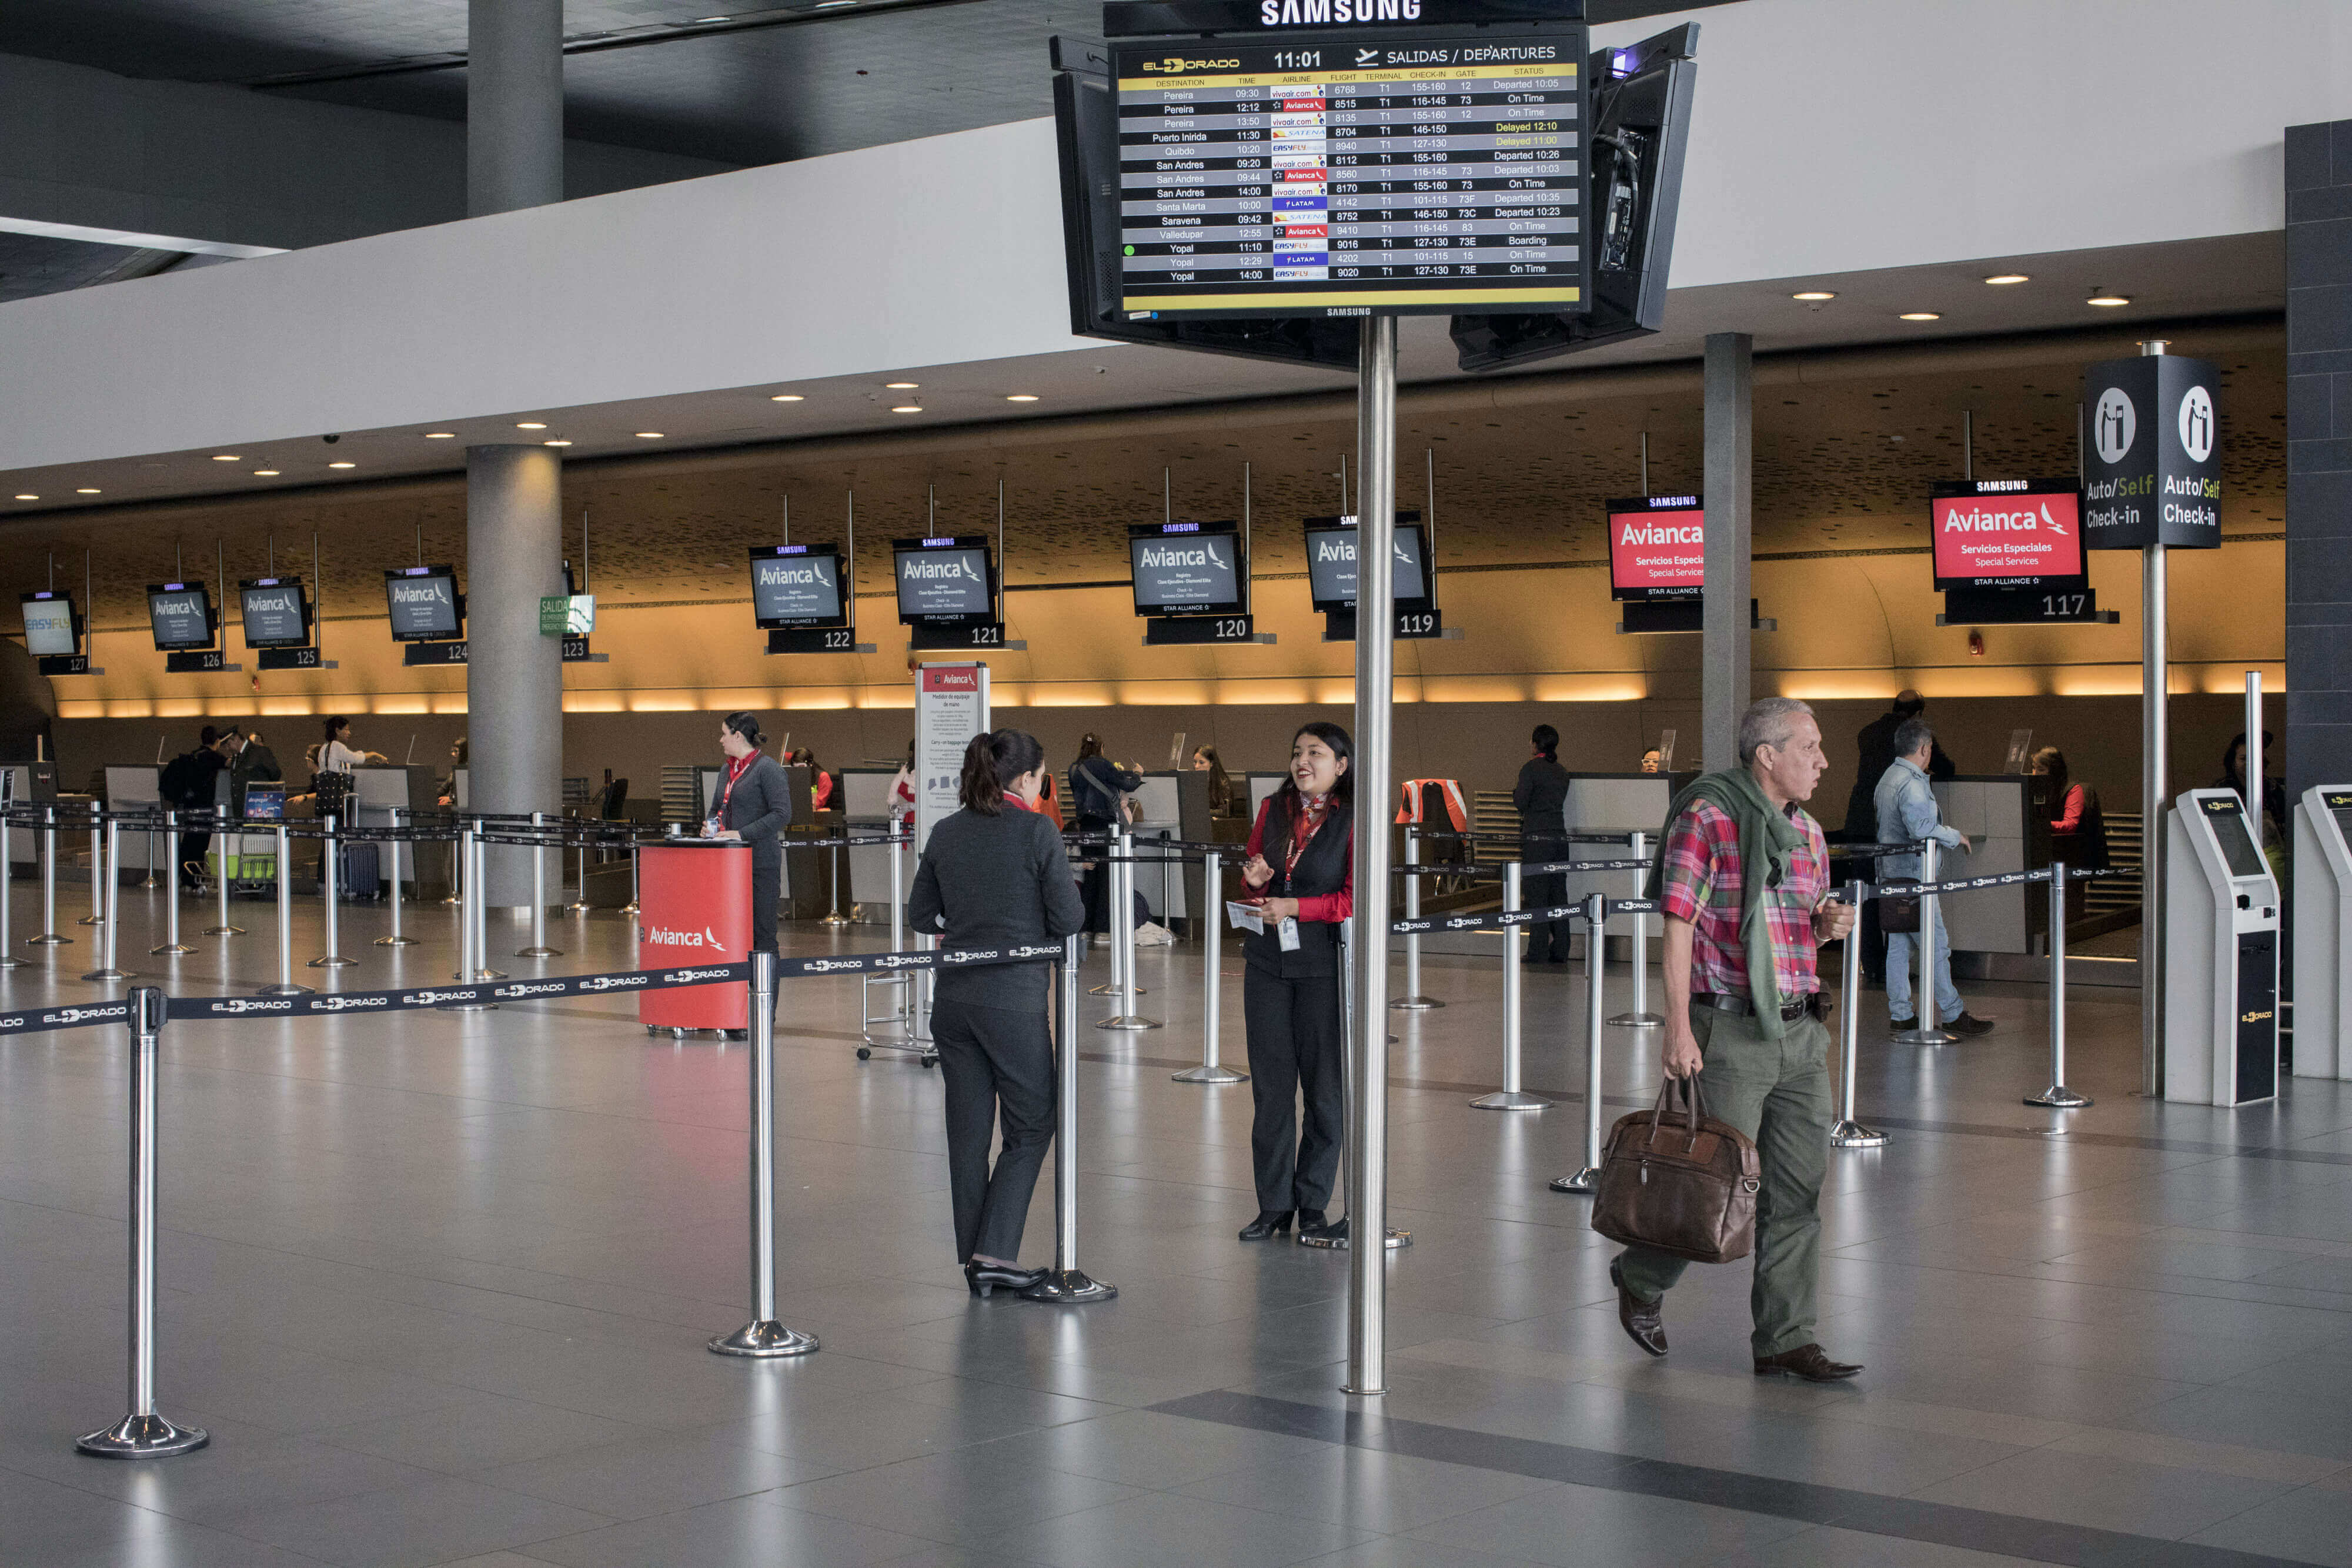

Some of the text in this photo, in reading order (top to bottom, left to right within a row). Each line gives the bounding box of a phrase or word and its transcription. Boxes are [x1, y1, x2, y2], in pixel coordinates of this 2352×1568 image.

[1261, 0, 1421, 25] SAMSUNG
[1274, 51, 1321, 68] 11:01
[1387, 50, 1448, 63] SALIDAS
[1464, 46, 1556, 61] DEPARTURES
[1156, 79, 1205, 87] DESTINATION
[1365, 72, 1402, 81] TERMINAL
[1164, 106, 1194, 114] Pereira
[1237, 103, 1259, 112] 12:12
[1335, 99, 1356, 109] 8515
[1380, 98, 1390, 106] T1
[1412, 96, 1446, 105] 116-145
[1461, 96, 1471, 105] 73
[1508, 95, 1522, 103] On
[1522, 94, 1544, 102] Time
[1152, 133, 1180, 142] Puerto
[1181, 133, 1207, 141] Inirida
[1237, 132, 1260, 141] 11:30
[1335, 128, 1357, 136] 8704
[1380, 126, 1391, 135] T1
[1412, 125, 1446, 133] 146-150
[1496, 123, 1531, 133] Delayed
[1532, 122, 1557, 131] 12:10
[1156, 161, 1174, 170] San
[1175, 160, 1204, 169] Andres
[1237, 159, 1260, 168] 09:20
[1336, 156, 1357, 165] 8112
[1381, 155, 1391, 163] T1
[1413, 153, 1447, 162] 155-160
[1494, 150, 1533, 161] Departed
[1535, 150, 1559, 159] 10:26
[1157, 189, 1174, 198] San
[1176, 188, 1205, 198] Andres
[1238, 187, 1261, 196] 14:00
[1337, 184, 1358, 193] 8170
[1381, 183, 1392, 192] T1
[1413, 181, 1447, 190] 155-160
[1461, 180, 1472, 190] 73
[1509, 179, 1523, 188] On
[1524, 179, 1545, 188] Time
[1161, 217, 1201, 226] Saravena
[1238, 215, 1261, 224] 09:42
[1337, 212, 1358, 221] 8752
[1381, 211, 1392, 220] T1
[1414, 209, 1448, 218] 146-150
[1458, 209, 1476, 218] 73C
[1495, 208, 1533, 218] Departed
[1536, 208, 1560, 216] 10:23
[1170, 243, 1194, 253] Yopal
[1239, 243, 1262, 252] 11:10
[1337, 240, 1358, 249] 9016
[1382, 239, 1392, 248] T1
[1414, 238, 1448, 246] 127-130
[1459, 238, 1476, 246] 73E
[1508, 236, 1546, 246] Boarding
[1170, 272, 1194, 281] Yopal
[1240, 271, 1262, 279] 14:00
[1338, 268, 1359, 277] 9020
[1382, 267, 1393, 276] T1
[1414, 266, 1449, 275] 127-130
[1459, 265, 1476, 274] 73E
[1510, 265, 1523, 273] On
[1524, 265, 1546, 273] Time
[1327, 307, 1371, 316] SAMSUNG
[1977, 480, 2029, 492] SAMSUNG
[1649, 496, 1696, 507] SAMSUNG
[1945, 507, 2037, 532] Avianca
[2087, 505, 2140, 528] Check-in
[2164, 503, 2216, 527] Check-in
[1162, 523, 1200, 533] SAMSUNG
[1621, 522, 1703, 546] Avianca
[776, 545, 807, 555] SAMSUNG
[923, 538, 955, 547] SAMSUNG
[1318, 540, 1357, 561] Avia
[1961, 543, 2052, 554] Servicios Especiales
[1141, 546, 1205, 567] Avianca
[1636, 557, 1673, 566] Servicios
[1975, 557, 2039, 568] Special Services
[760, 566, 813, 585] Avianca
[904, 560, 961, 579] Avianca
[1649, 569, 1674, 579] Special
[394, 586, 435, 603] Avianca
[155, 601, 189, 616] Avianca
[248, 597, 284, 612] Avianca
[542, 600, 568, 613] SALIDA
[2043, 594, 2085, 616] 117
[1216, 620, 1246, 637] 120
[1401, 614, 1434, 633] 119
[825, 631, 850, 647] 122
[972, 627, 998, 643] 121
[298, 651, 315, 664] 125
[449, 645, 468, 659] 124
[563, 642, 584, 657] 123
[71, 658, 85, 670] 127
[203, 654, 219, 667] 126
[944, 674, 968, 684] Avianca
[650, 926, 703, 947] Avianca
